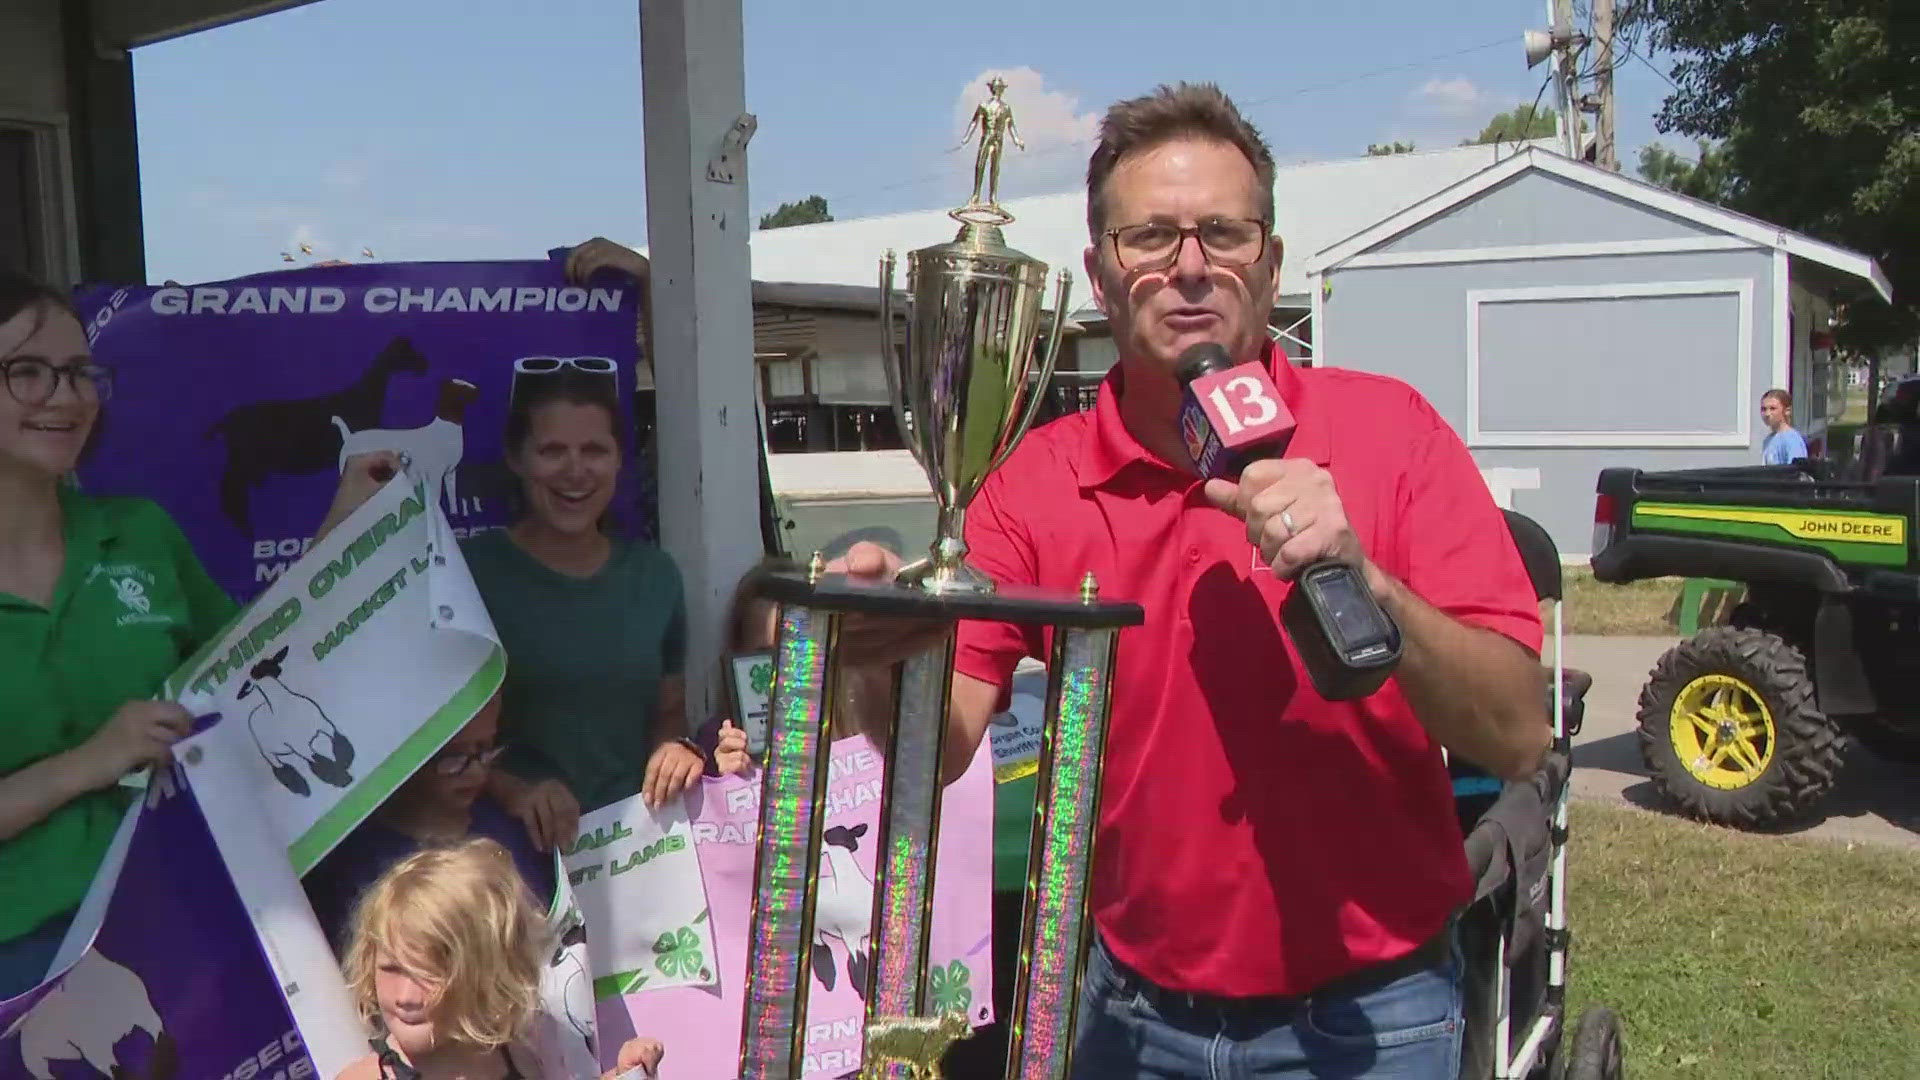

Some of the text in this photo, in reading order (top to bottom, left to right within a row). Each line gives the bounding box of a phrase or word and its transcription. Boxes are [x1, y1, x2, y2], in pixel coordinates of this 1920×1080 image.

[150, 286, 623, 315] GRAND CHAMPION
[1209, 377, 1277, 436] 13
[1799, 520, 1893, 537] JOHN DEERE
[312, 566, 409, 662] MARKET
[191, 596, 303, 697] THIRD
[610, 835, 686, 877] LAMB
